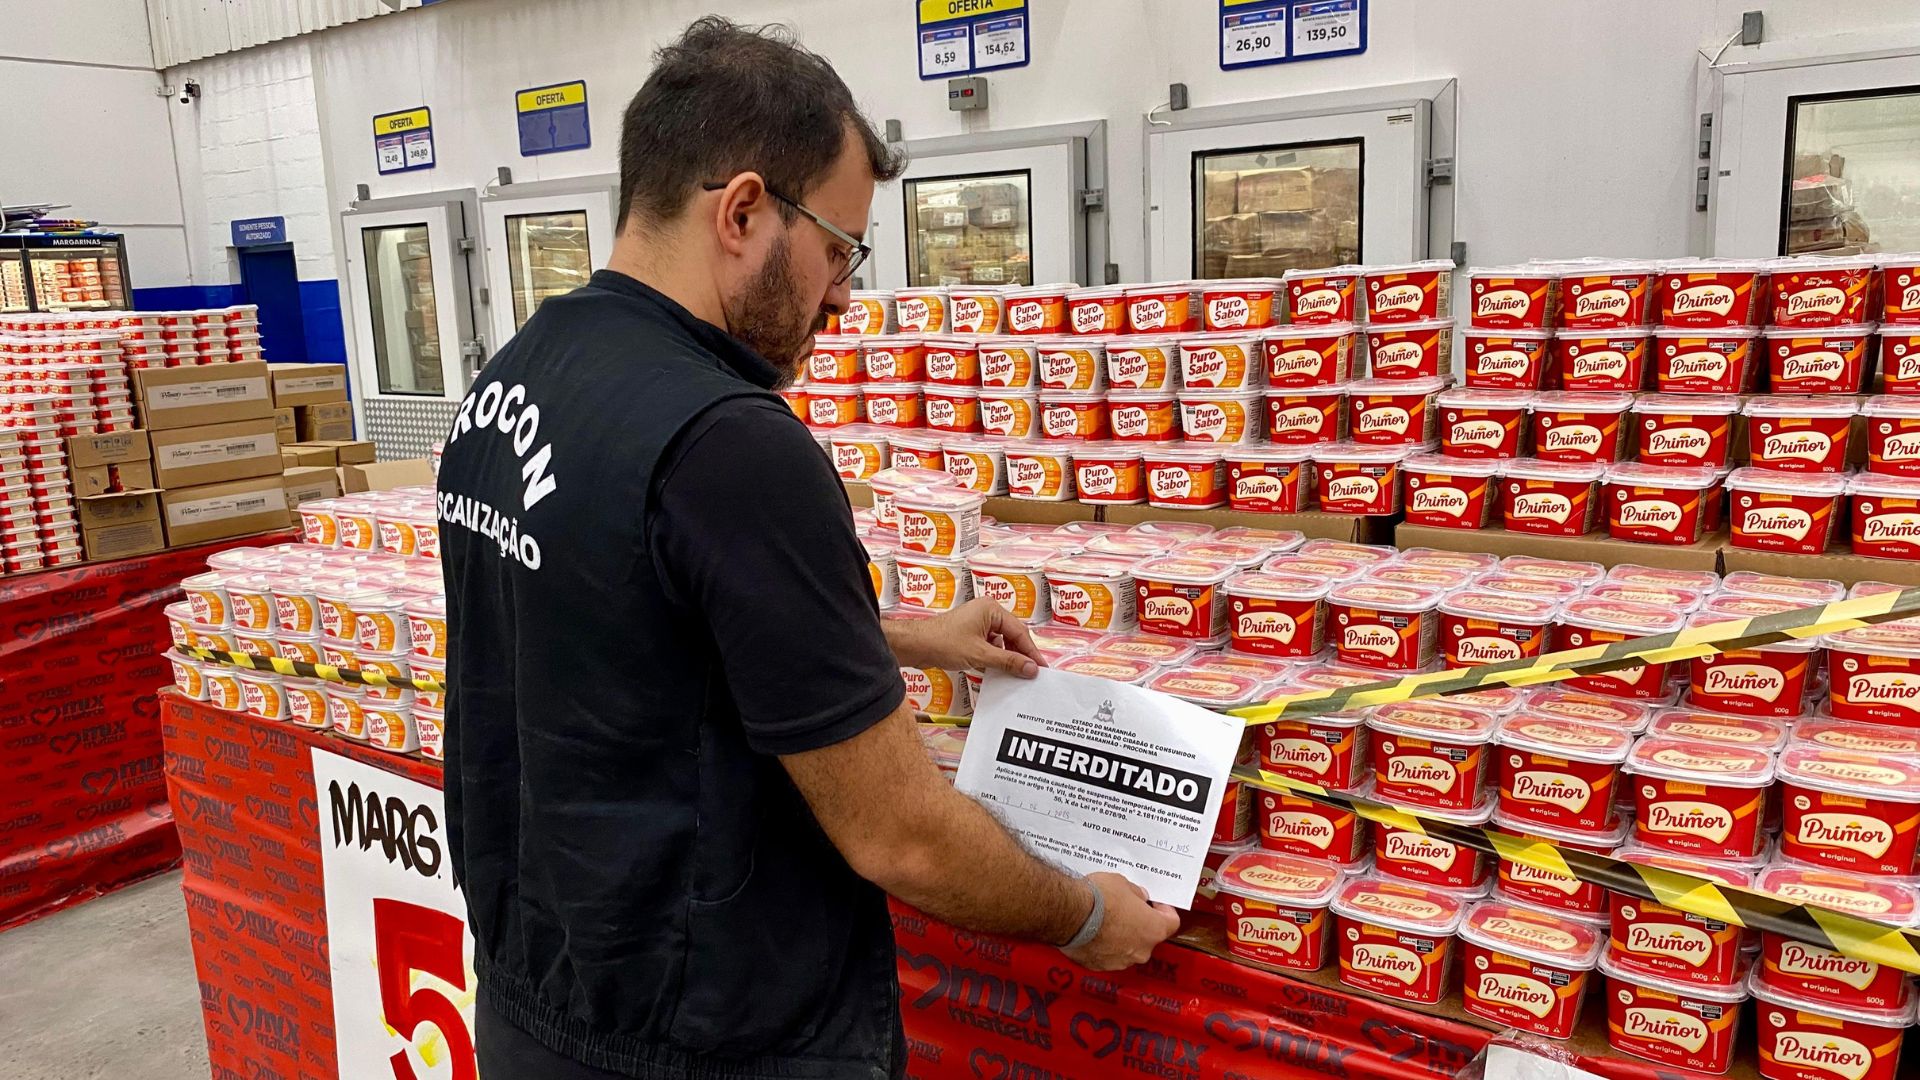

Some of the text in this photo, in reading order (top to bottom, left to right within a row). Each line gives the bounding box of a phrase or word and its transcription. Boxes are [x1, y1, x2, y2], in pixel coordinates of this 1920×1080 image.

[1306, 26, 1346, 41] 139,50
[985, 42, 1015, 55] 154,62
[1236, 36, 1271, 52] 26,90
[935, 52, 956, 65] 8,59
[536, 92, 565, 106] OFERTA
[389, 117, 414, 130] OFERTA
[384, 154, 398, 164] 12,49
[53, 238, 101, 246] MARGARINAS
[1215, 298, 1241, 311] Puro
[1377, 293, 1420, 309] Primor
[1480, 296, 1526, 312] Primor
[1676, 292, 1731, 310] Primor
[1790, 294, 1842, 310] Primor
[1214, 308, 1247, 322] Sabor
[1189, 350, 1217, 365] Puro
[1786, 357, 1840, 374] Primor
[1188, 360, 1224, 375] Sabor
[872, 399, 891, 410] Puro
[872, 407, 897, 418] Sabor
[1195, 408, 1219, 419] Puro
[1362, 414, 1405, 429] Primor
[1194, 416, 1225, 429] Sabor
[451, 381, 557, 511] ROCON
[837, 447, 858, 458] Puro
[1767, 439, 1826, 455] Primor
[837, 455, 863, 468] Sabor
[1157, 470, 1183, 481] Puro
[1156, 479, 1189, 492] Sabor
[1517, 499, 1567, 515] Primor
[903, 514, 927, 527] Puro
[1747, 512, 1807, 530] Primor
[437, 491, 541, 571] SCALIZAÇÃO
[903, 525, 934, 538] Sabor
[232, 597, 246, 608] Puro
[1059, 590, 1084, 601] Puro
[234, 606, 251, 616] Sabor
[1058, 599, 1090, 611] Sabor
[412, 622, 428, 633] Puro
[412, 632, 434, 643] Sabor
[1461, 642, 1516, 660] Primor
[1710, 670, 1779, 690] Primor
[1729, 700, 1754, 708] original
[1775, 707, 1790, 715] 500g
[1017, 713, 1045, 723] INSTITUTO
[1054, 721, 1084, 732] PROMOÇÃO
[1090, 730, 1112, 739] DEFESA
[1123, 737, 1148, 748] CIDADÃO
[1155, 745, 1196, 759] CONSUMIDOR
[1072, 719, 1093, 728] ESTADO
[1103, 726, 1136, 737] MARANHÃO
[1055, 728, 1076, 737] ESTADO
[1086, 734, 1118, 747] MARANHÃO
[1273, 743, 1327, 762] Primor
[1007, 736, 1199, 802] INTERDITADO
[1517, 774, 1585, 799] Primor
[994, 773, 1017, 783] prevista
[1026, 781, 1045, 791] artigo
[1077, 793, 1103, 806] Decreto
[1104, 801, 1128, 813] Federal
[1136, 811, 1172, 824] 2.181/1997
[1178, 822, 1199, 832] artigo
[996, 766, 1023, 778] Aplica-se
[1028, 774, 1050, 784] medida
[1050, 780, 1077, 791] cautelar
[1086, 789, 1120, 804] suspensão
[1121, 797, 1156, 813] temporária
[1167, 811, 1201, 824] atividades
[1080, 802, 1090, 810] Lei
[1535, 808, 1560, 817] original
[1580, 818, 1596, 827] 500g
[1652, 806, 1726, 829] Primor
[328, 779, 442, 880] MARG.
[1082, 821, 1101, 831] AUTO
[1112, 829, 1147, 844] INFRAÇÃO
[1272, 816, 1329, 837] Primor
[1804, 818, 1887, 844] Primor
[1026, 831, 1048, 842] Castelo
[1049, 837, 1070, 849] Branco,
[1092, 849, 1104, 858] São
[1104, 853, 1134, 867] Francisco,
[1135, 862, 1150, 871] CEP:
[1034, 840, 1060, 852] Telefone:
[1389, 837, 1451, 859] Primor
[1827, 853, 1856, 863] original
[1880, 865, 1898, 873] 500g
[1241, 921, 1297, 942] Primor
[1632, 927, 1707, 952] Primor
[1356, 948, 1417, 972] Primor
[1785, 945, 1871, 974] Primor
[1691, 973, 1708, 981] 500g
[372, 898, 478, 1080] 5
[950, 965, 1058, 1028] mix
[1483, 977, 1549, 1004] Primor
[255, 1005, 301, 1047] mix
[950, 1006, 1054, 1050] mateus
[1628, 1011, 1702, 1039] Primor
[1124, 1025, 1209, 1072] mix
[1780, 1036, 1864, 1066] Primor
